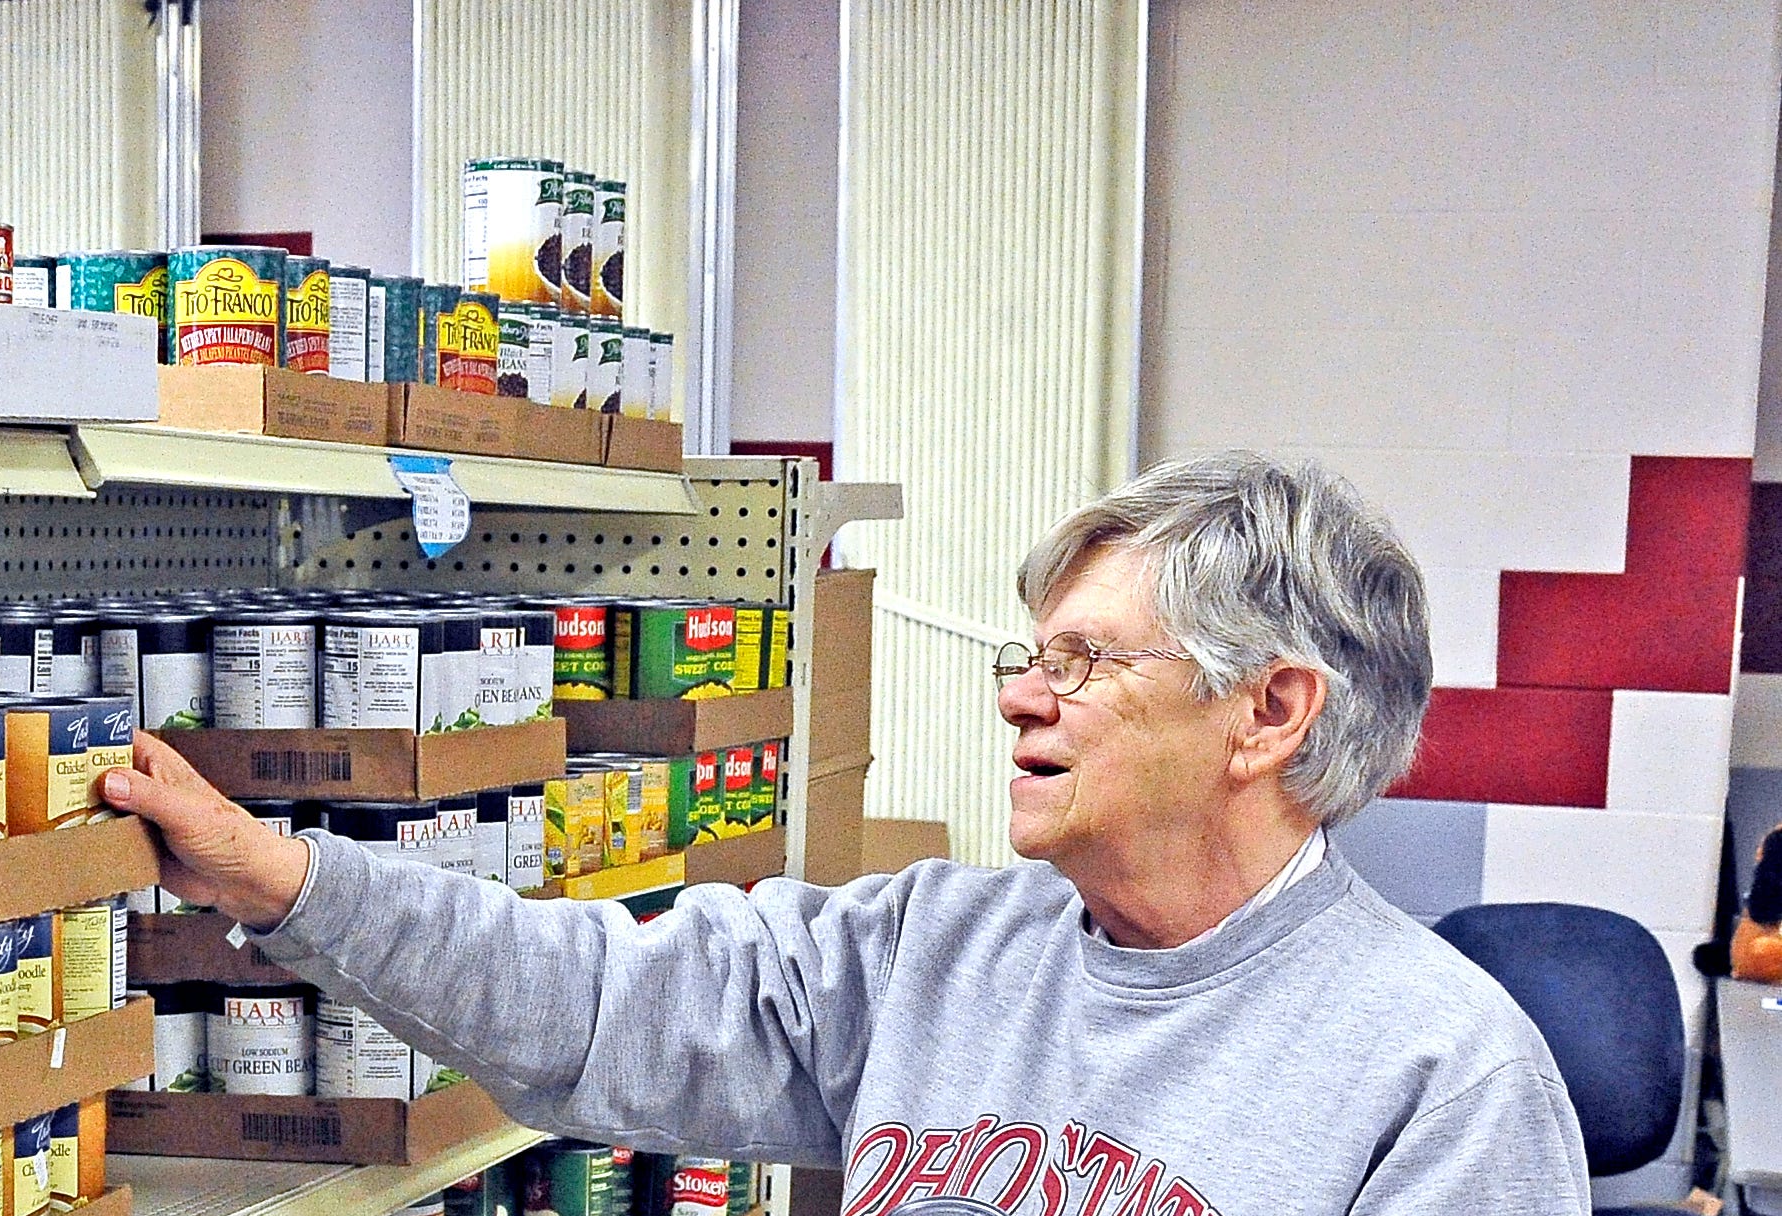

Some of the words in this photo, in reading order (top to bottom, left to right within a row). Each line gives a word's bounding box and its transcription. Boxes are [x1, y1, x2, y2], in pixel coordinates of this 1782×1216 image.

[239, 628, 260, 638] Facts
[249, 660, 260, 670] 15
[347, 661, 358, 671] 15
[19, 965, 46, 979] oodle
[227, 1001, 302, 1018] HART
[242, 1048, 258, 1057] LOW
[259, 1048, 289, 1057] SODIUM
[233, 1060, 280, 1075] GREEN
